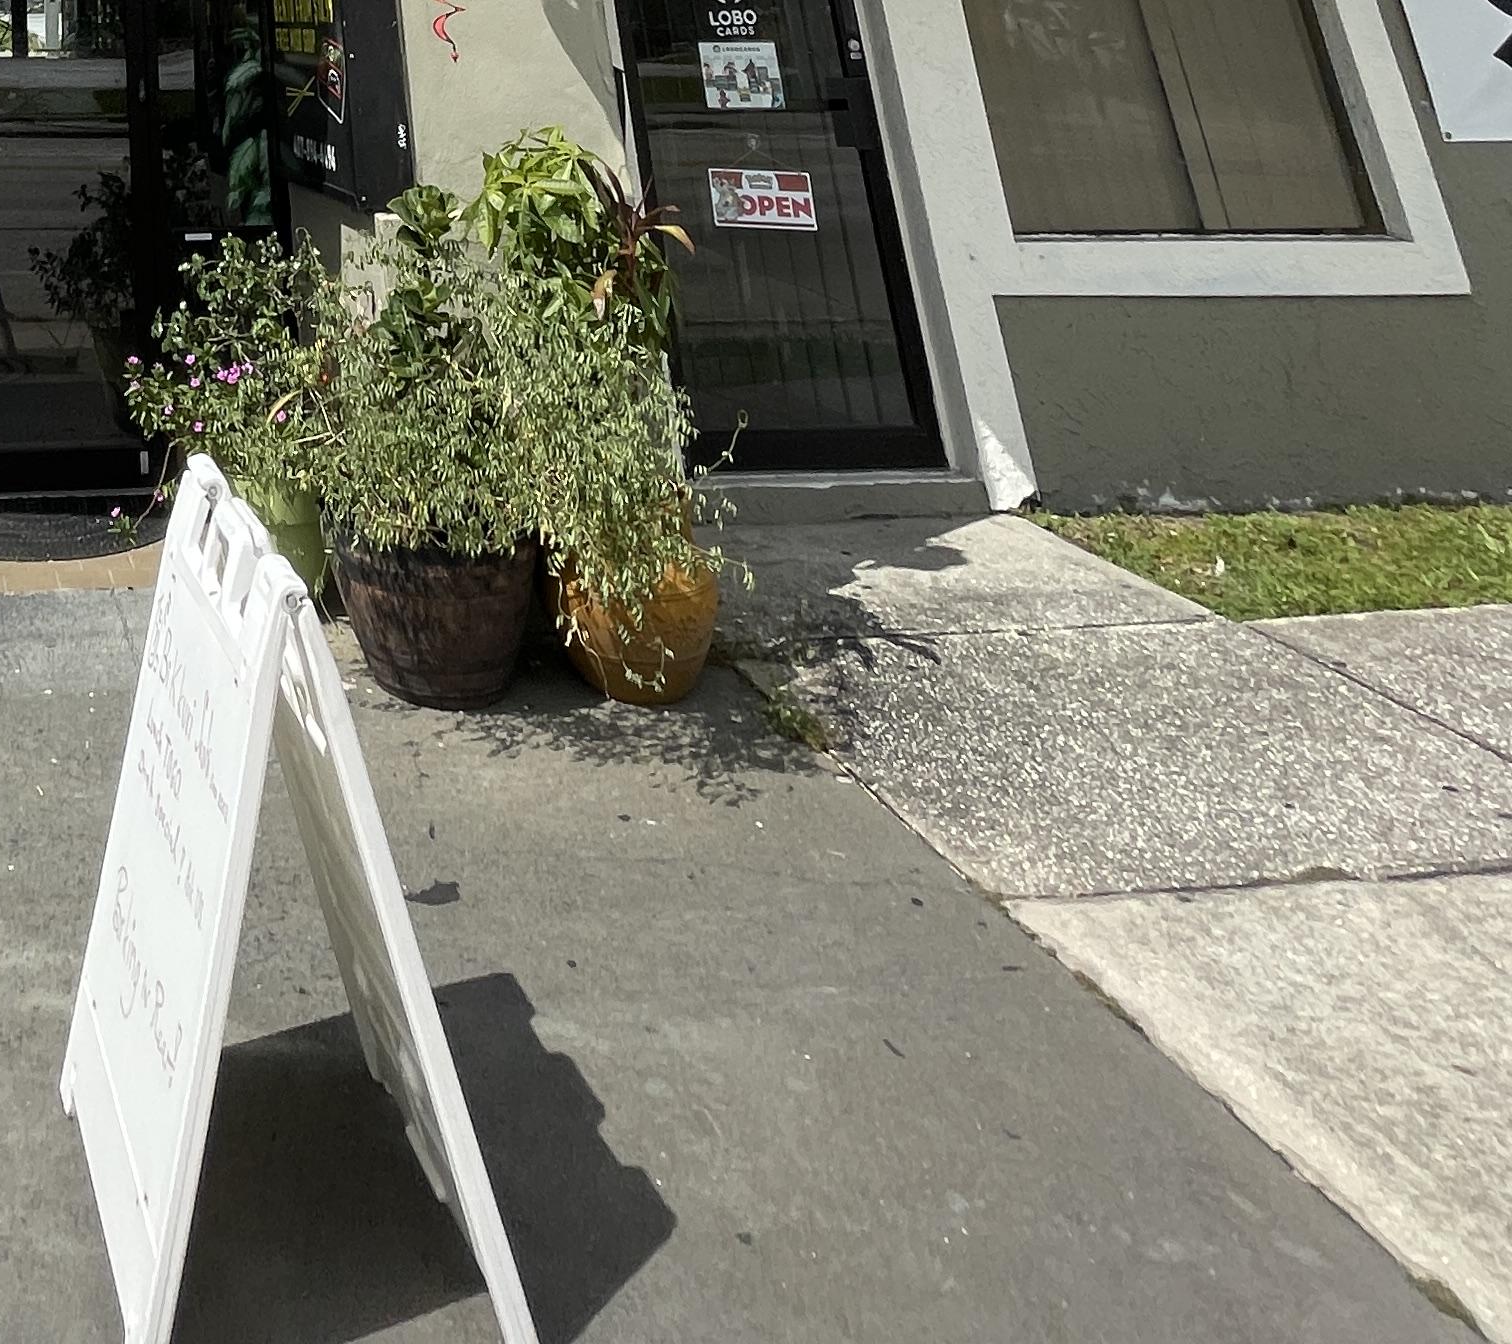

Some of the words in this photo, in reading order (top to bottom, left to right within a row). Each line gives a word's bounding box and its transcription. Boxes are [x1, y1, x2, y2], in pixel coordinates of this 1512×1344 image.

[708, 9, 758, 27] LOBO
[716, 26, 755, 37] CARDS
[741, 194, 813, 219] OPEN
